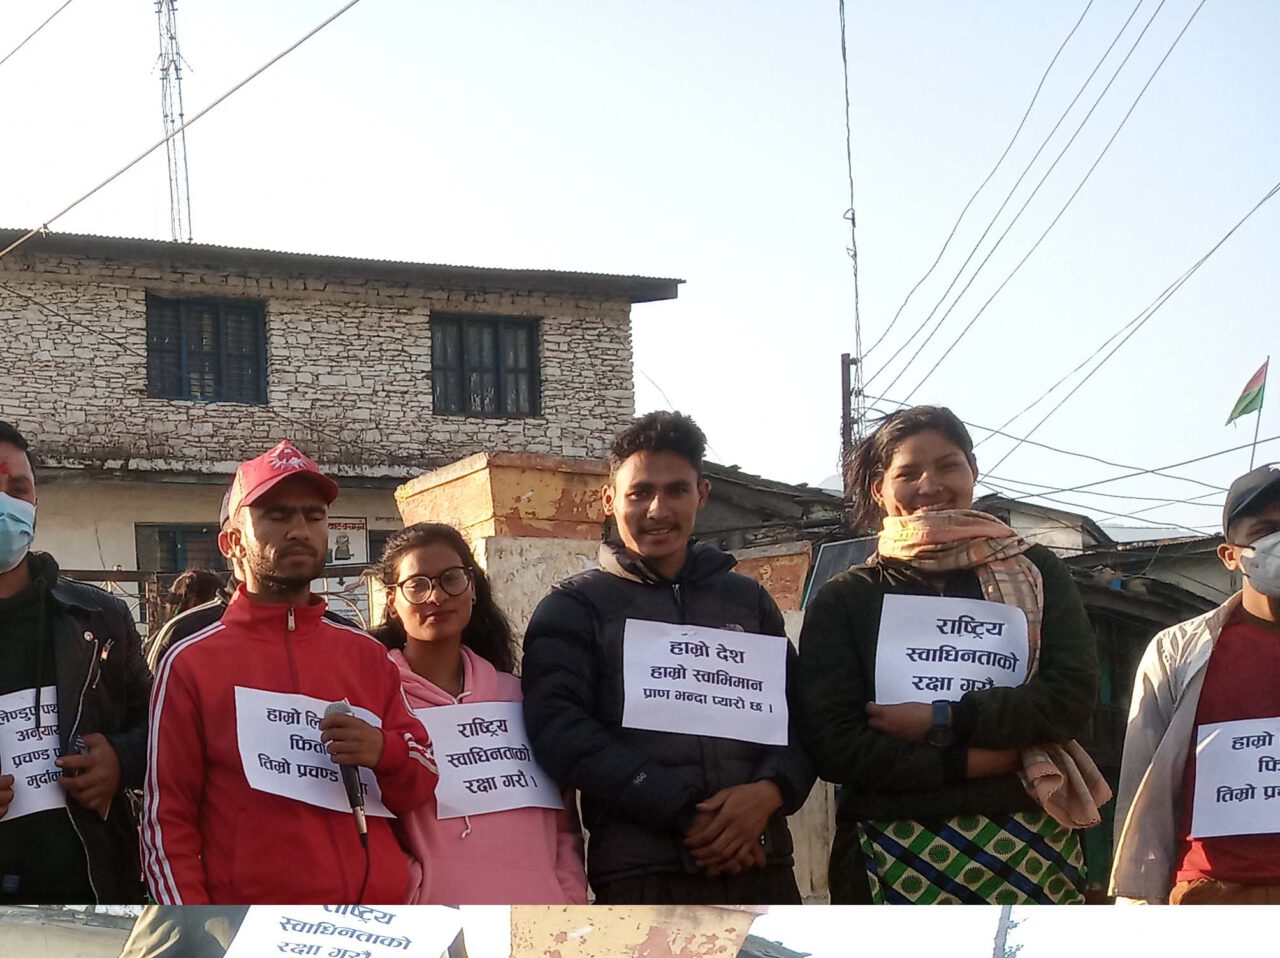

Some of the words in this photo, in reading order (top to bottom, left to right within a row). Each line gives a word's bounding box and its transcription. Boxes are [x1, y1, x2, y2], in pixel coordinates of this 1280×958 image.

[669, 640, 710, 658] हाम्रो
[715, 643, 746, 664] देश
[650, 664, 687, 680] हाम्रो
[692, 669, 764, 692] स्वाभिमान
[912, 675, 954, 692] रक्षा
[675, 690, 708, 704] भन्दा
[266, 708, 301, 725] हाम्रो
[1232, 731, 1275, 750] हाम्रो
[11, 748, 51, 768] प्रचण्ड
[257, 753, 291, 774] तिम्रो
[296, 764, 339, 782] प्रचण्ड
[463, 776, 497, 793] रक्षा
[1216, 783, 1257, 802] तिम्रो
[277, 941, 321, 957] रक्षा
